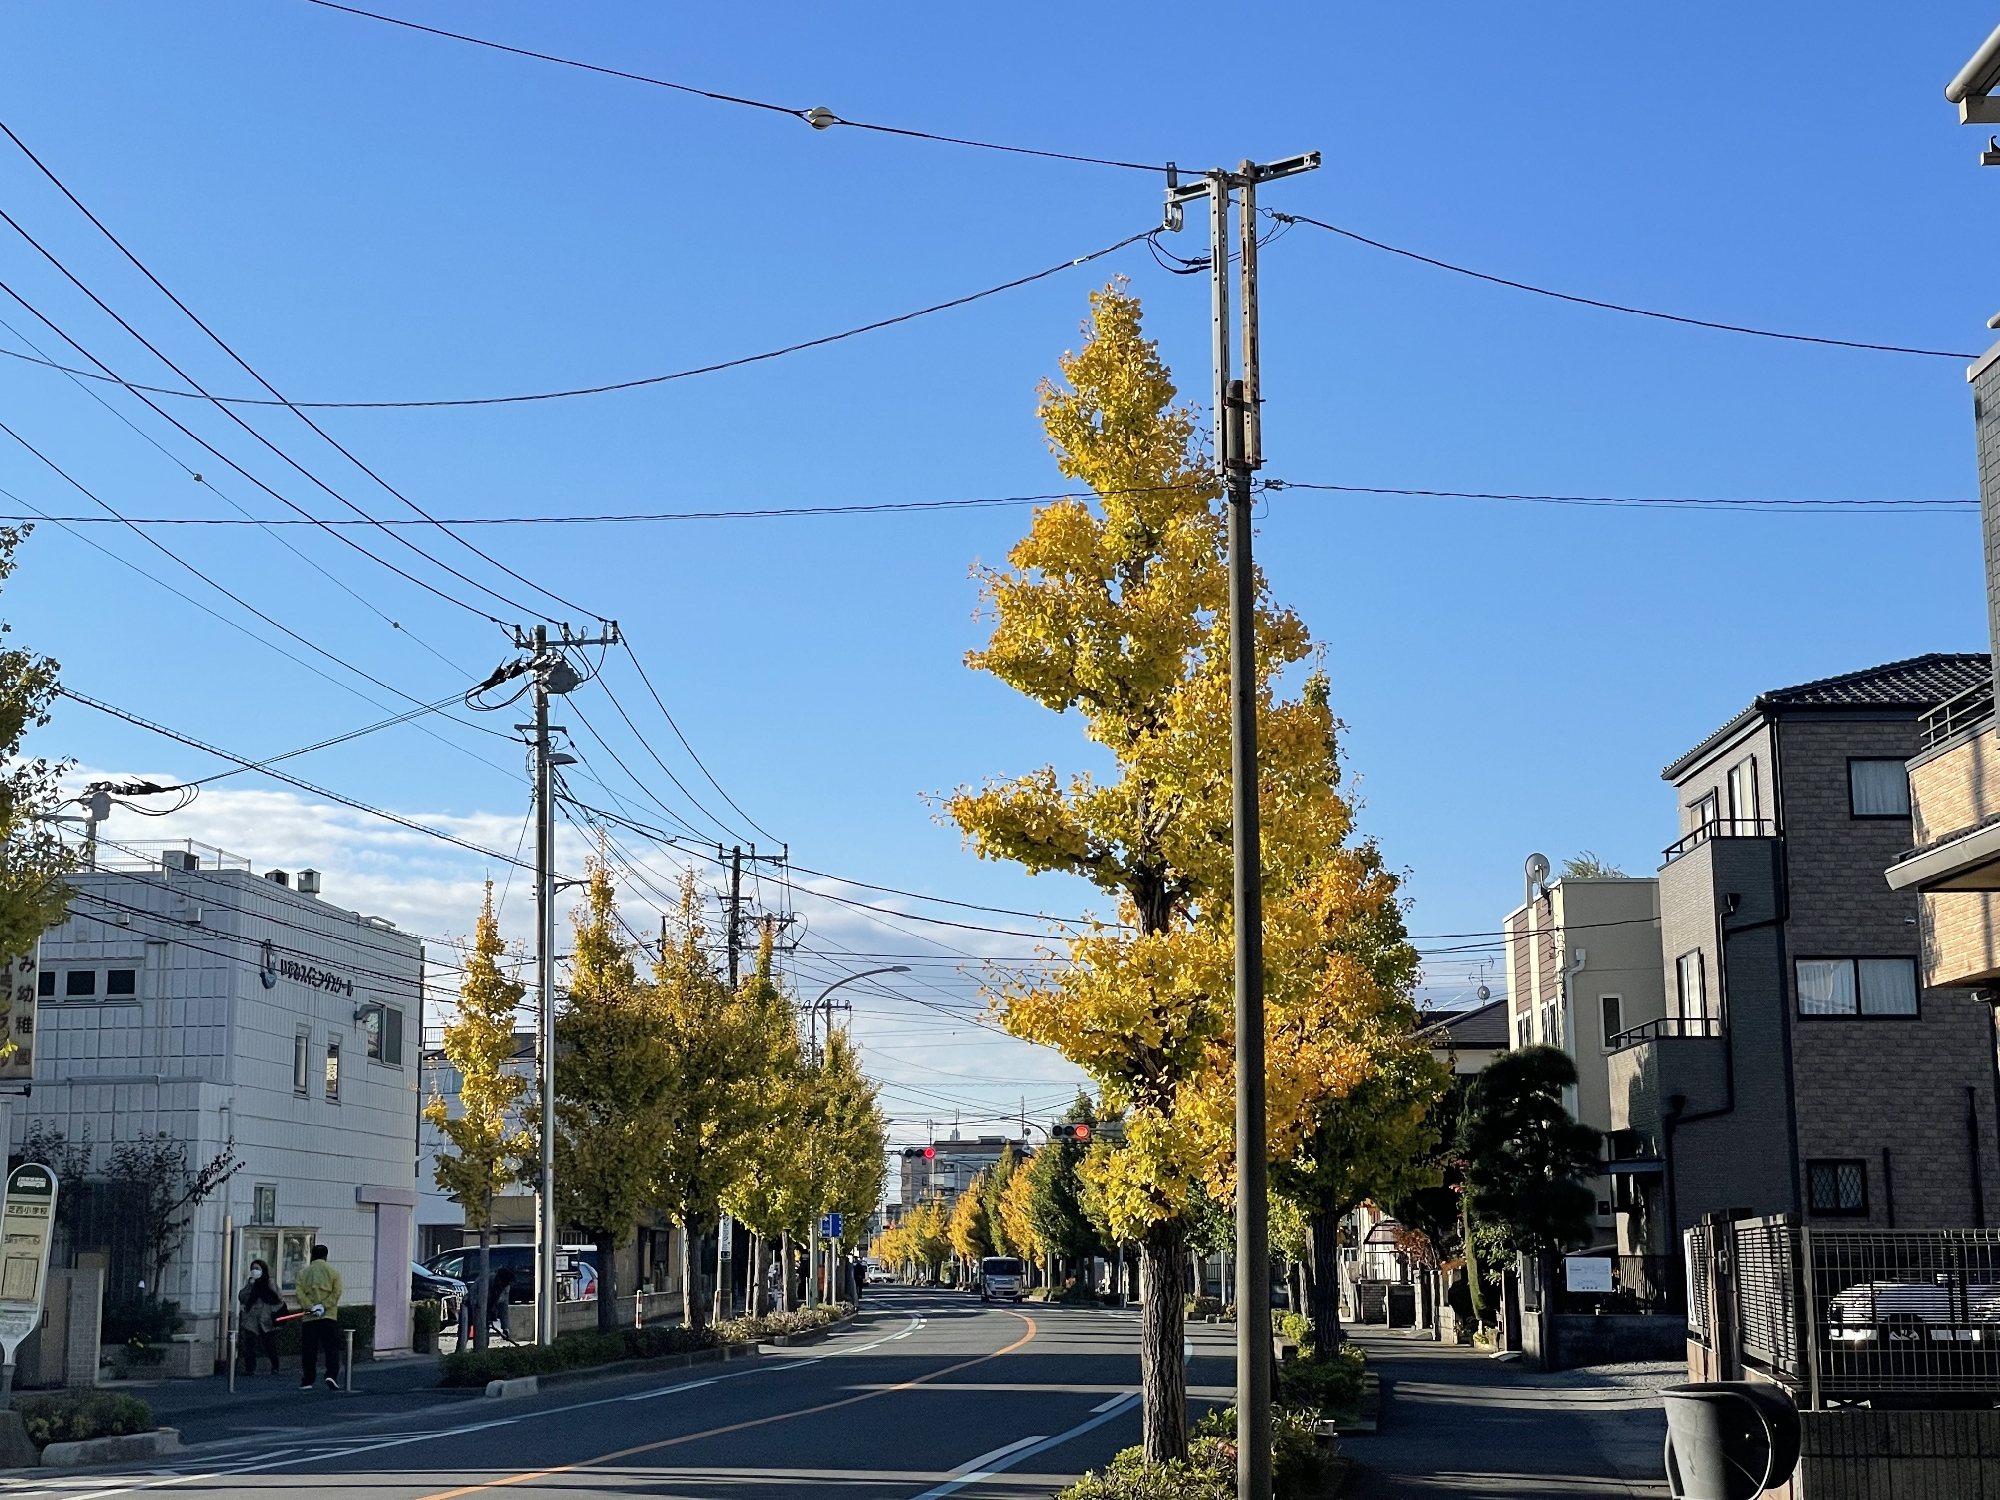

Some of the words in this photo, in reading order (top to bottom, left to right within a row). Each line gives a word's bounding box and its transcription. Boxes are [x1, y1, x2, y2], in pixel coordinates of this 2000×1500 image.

[8, 1205, 47, 1214] 芝西小学校
